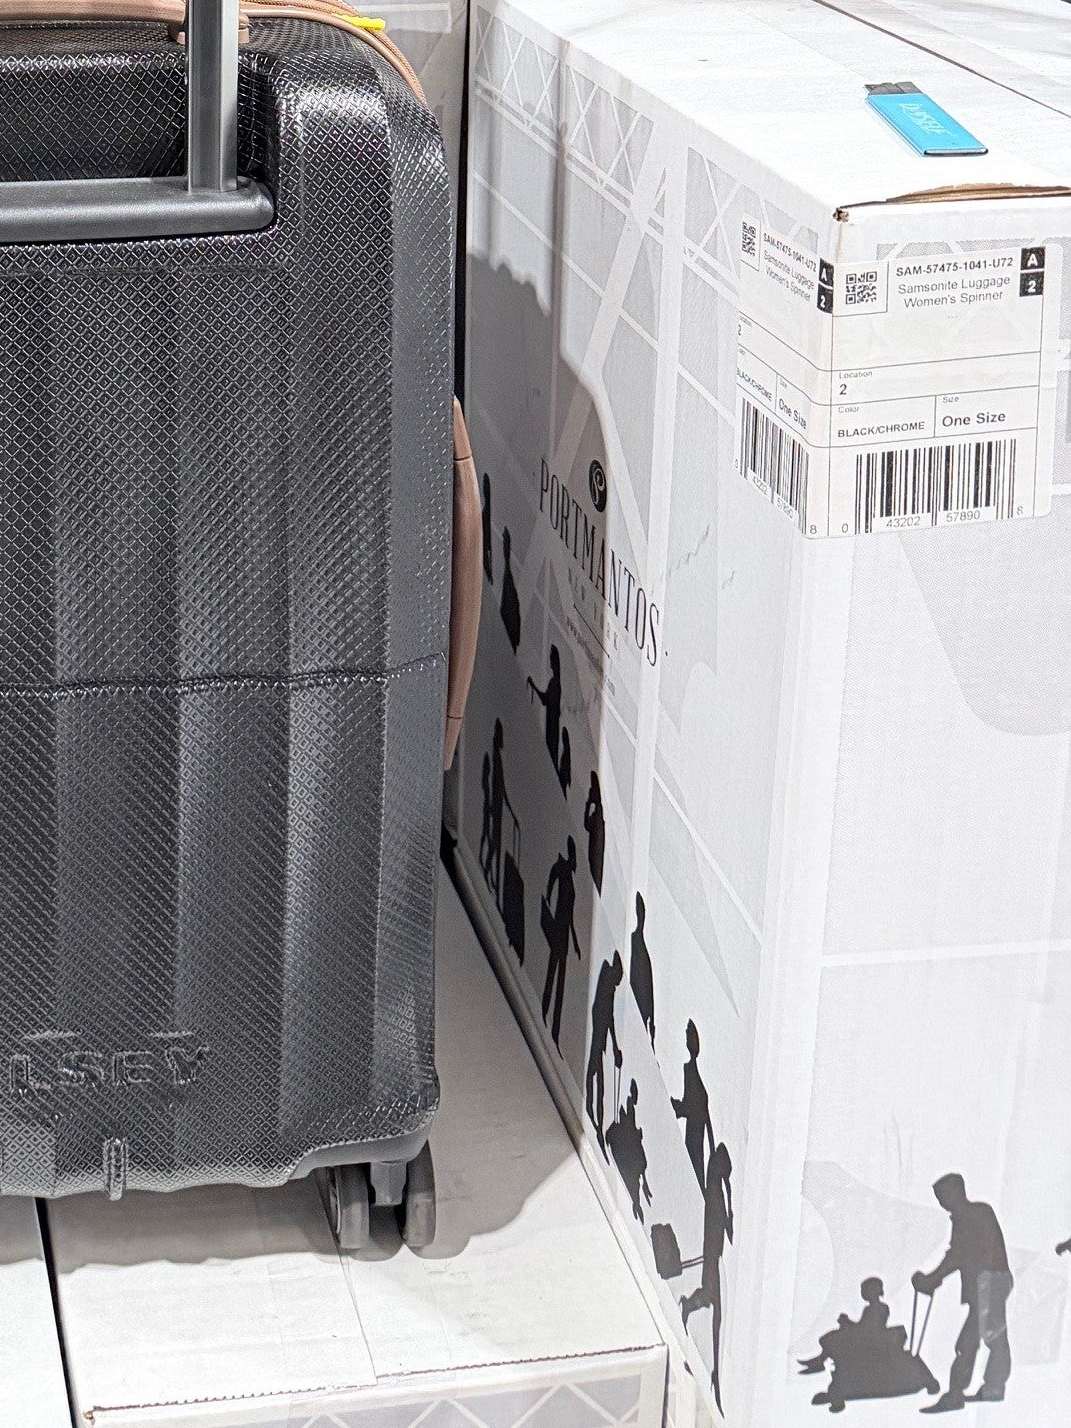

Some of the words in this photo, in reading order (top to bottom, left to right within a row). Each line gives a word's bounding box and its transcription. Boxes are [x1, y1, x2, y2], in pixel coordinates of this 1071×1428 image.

[896, 257, 1014, 277] SAM-57475-1041-U72
[791, 269, 815, 290] Luggage
[898, 281, 959, 295] Samsonite
[961, 276, 1011, 291] Luggage
[790, 281, 811, 302] Spinner
[903, 294, 956, 309] Women's
[960, 291, 1003, 305] Spinner
[838, 370, 873, 379] Location
[839, 384, 848, 395] 2
[942, 396, 960, 404] Size
[778, 398, 792, 418] One
[793, 410, 807, 430] Size
[942, 414, 971, 427] One
[976, 411, 1006, 424] Size
[837, 421, 925, 438] BLACK/CHROME
[809, 524, 817, 535] 8
[841, 523, 849, 534] 0
[886, 516, 921, 528] 43202
[945, 510, 981, 522] 57890
[539, 458, 659, 667] PORTMANTOS
